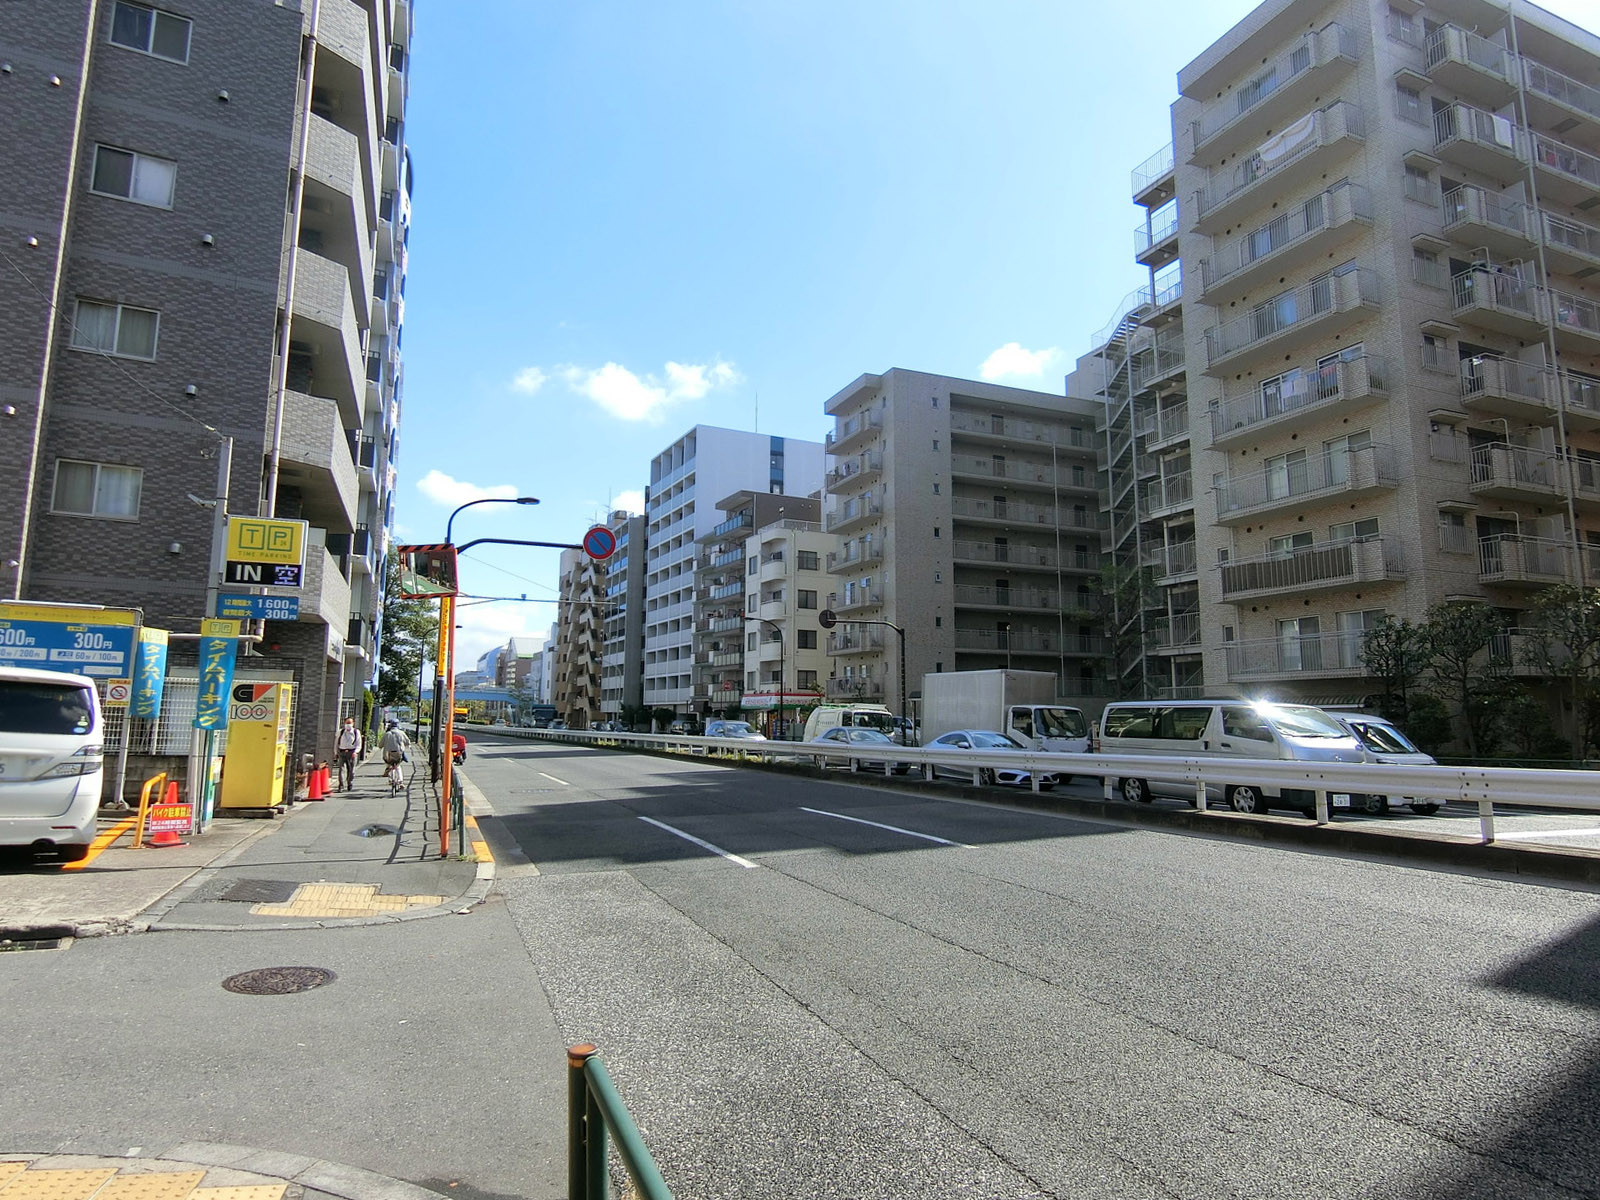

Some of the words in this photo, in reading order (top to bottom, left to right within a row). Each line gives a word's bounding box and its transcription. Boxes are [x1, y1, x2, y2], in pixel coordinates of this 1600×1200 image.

[236, 564, 262, 582] IN
[274, 565, 298, 585] 空
[264, 609, 297, 620] 300円
[74, 632, 112, 650] 300円
[136, 644, 161, 715] タイムパーキング
[199, 639, 228, 727] タイムパーキング
[230, 704, 268, 720] 100
